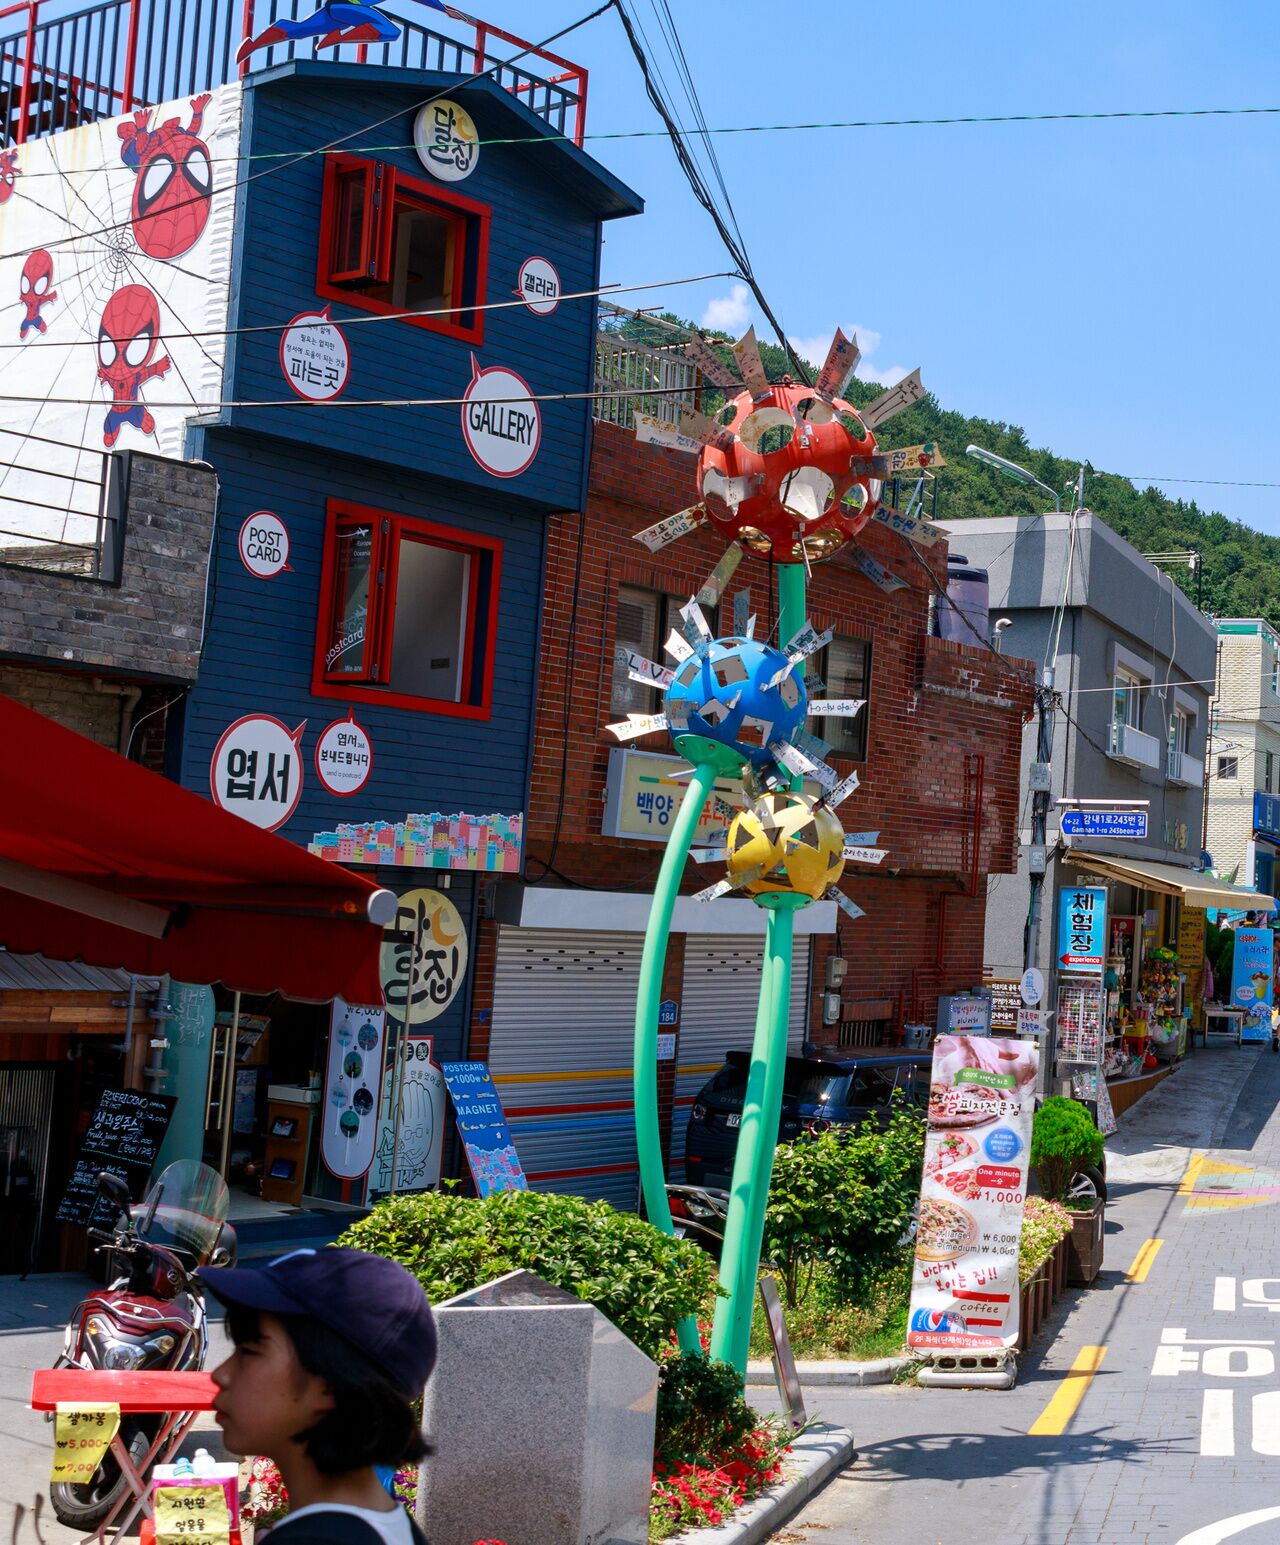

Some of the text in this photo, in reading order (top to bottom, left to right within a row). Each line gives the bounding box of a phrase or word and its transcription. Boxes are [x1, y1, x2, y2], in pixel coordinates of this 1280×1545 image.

[524, 272, 556, 297] 갤러리
[290, 358, 339, 390] 파는곳
[469, 401, 536, 446] GALLERY
[249, 527, 283, 547] POST
[246, 544, 282, 563] CARD
[325, 627, 363, 665] postcard
[337, 733, 357, 747] 엽서
[321, 749, 369, 766] 보내드립니다
[226, 748, 291, 804] 엽서
[637, 792, 673, 826] 백양
[1070, 892, 1095, 952] 체험장
[1068, 956, 1101, 966] experience
[661, 1012, 674, 1022] 184
[443, 1064, 484, 1073] POSTCARD
[457, 1104, 498, 1115] MAGNET
[978, 1168, 1019, 1178] One minute
[922, 1261, 957, 1278] 바다가
[936, 1273, 967, 1292] 보이는
[961, 1303, 999, 1313] coffee
[68, 1412, 106, 1426] 셀카봉
[172, 1497, 206, 1510] 시원한
